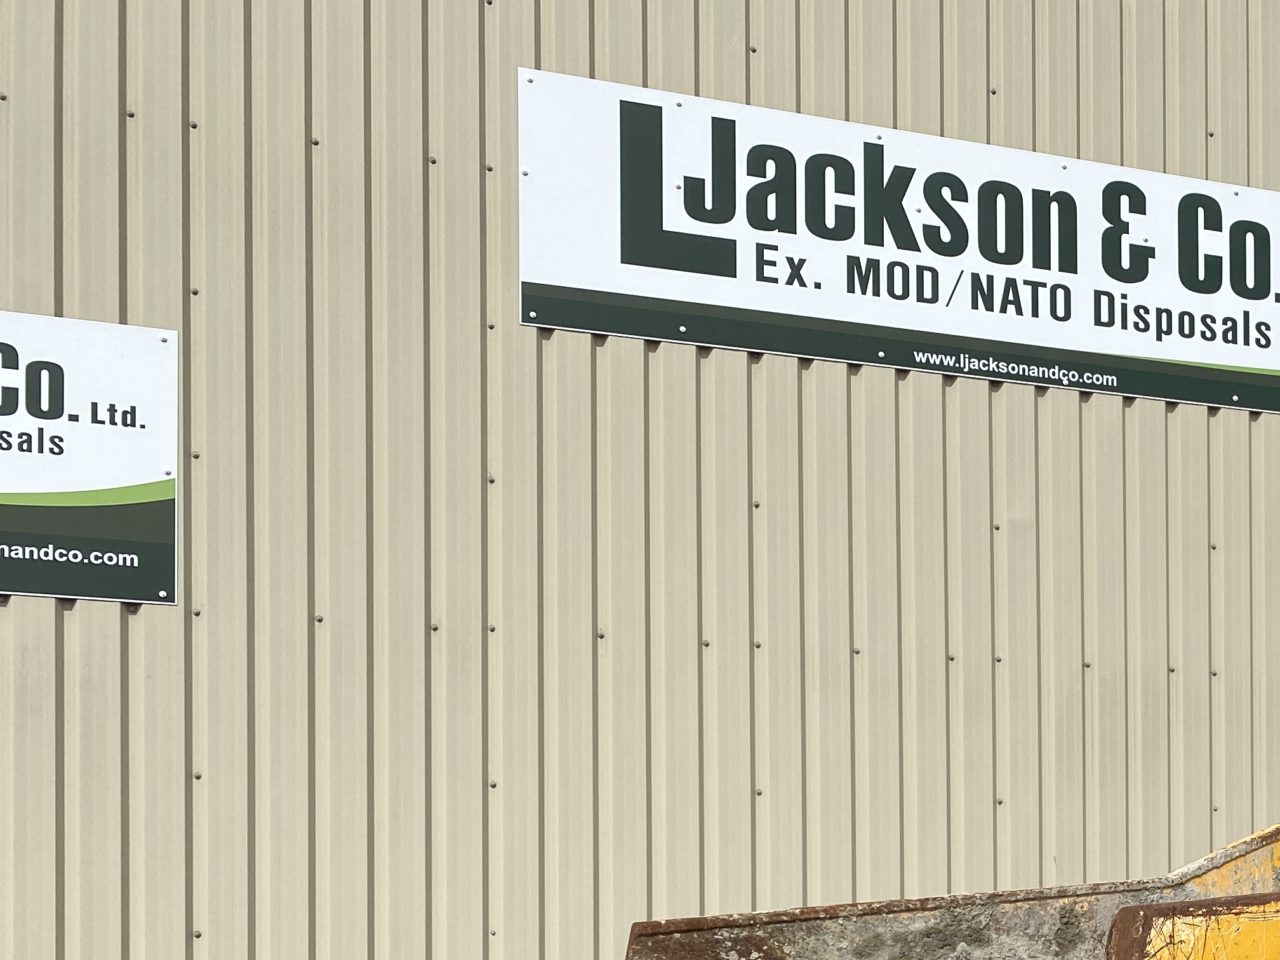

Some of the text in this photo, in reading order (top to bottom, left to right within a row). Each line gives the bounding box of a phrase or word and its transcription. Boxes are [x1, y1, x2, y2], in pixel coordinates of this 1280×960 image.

[1101, 181, 1156, 283] &
[755, 242, 1272, 349] Ex. MOD/NATO Disposals
[913, 351, 1118, 387] www.ljacksonandco.com
[90, 401, 146, 429] Ltd.
